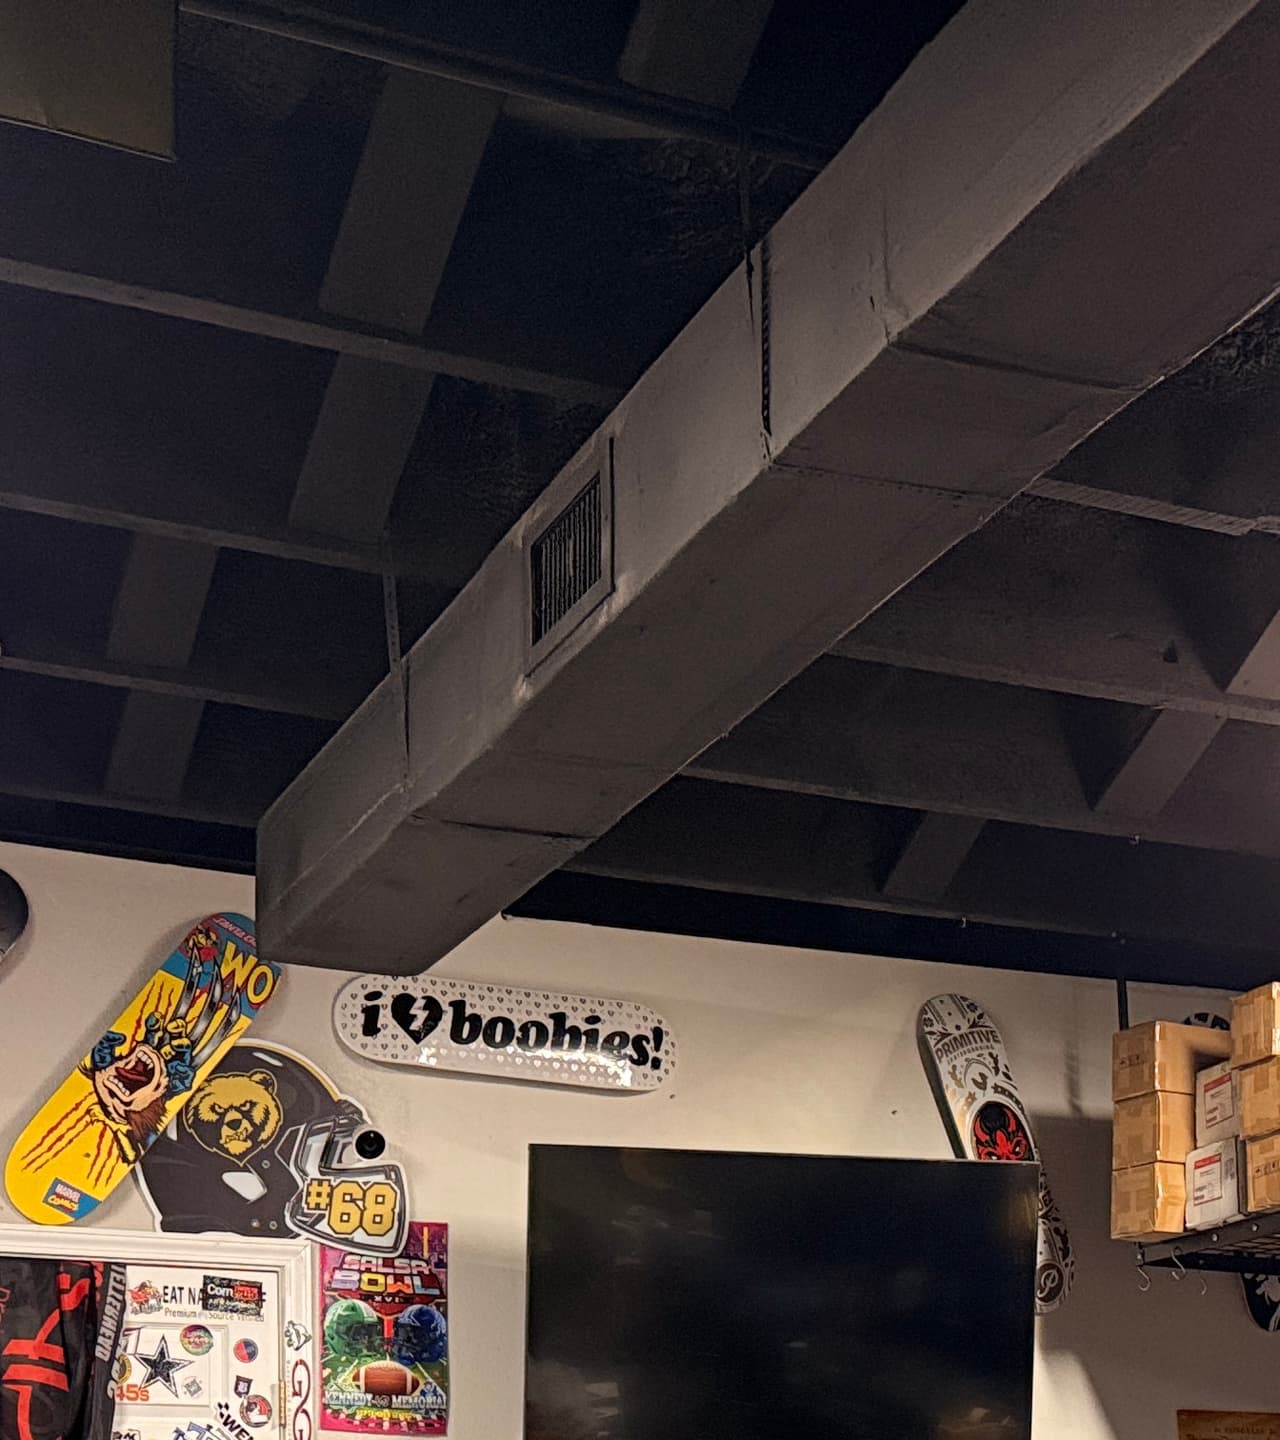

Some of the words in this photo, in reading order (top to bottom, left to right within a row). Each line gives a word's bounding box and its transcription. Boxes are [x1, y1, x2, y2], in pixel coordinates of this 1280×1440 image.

[448, 999, 665, 1071] boobies!
[935, 1028, 1000, 1063] PRIMITIVE
[306, 1178, 397, 1237] #68
[342, 1254, 431, 1275] SALSA
[163, 1286, 185, 1304] EAT
[331, 1269, 441, 1296] BOWL
